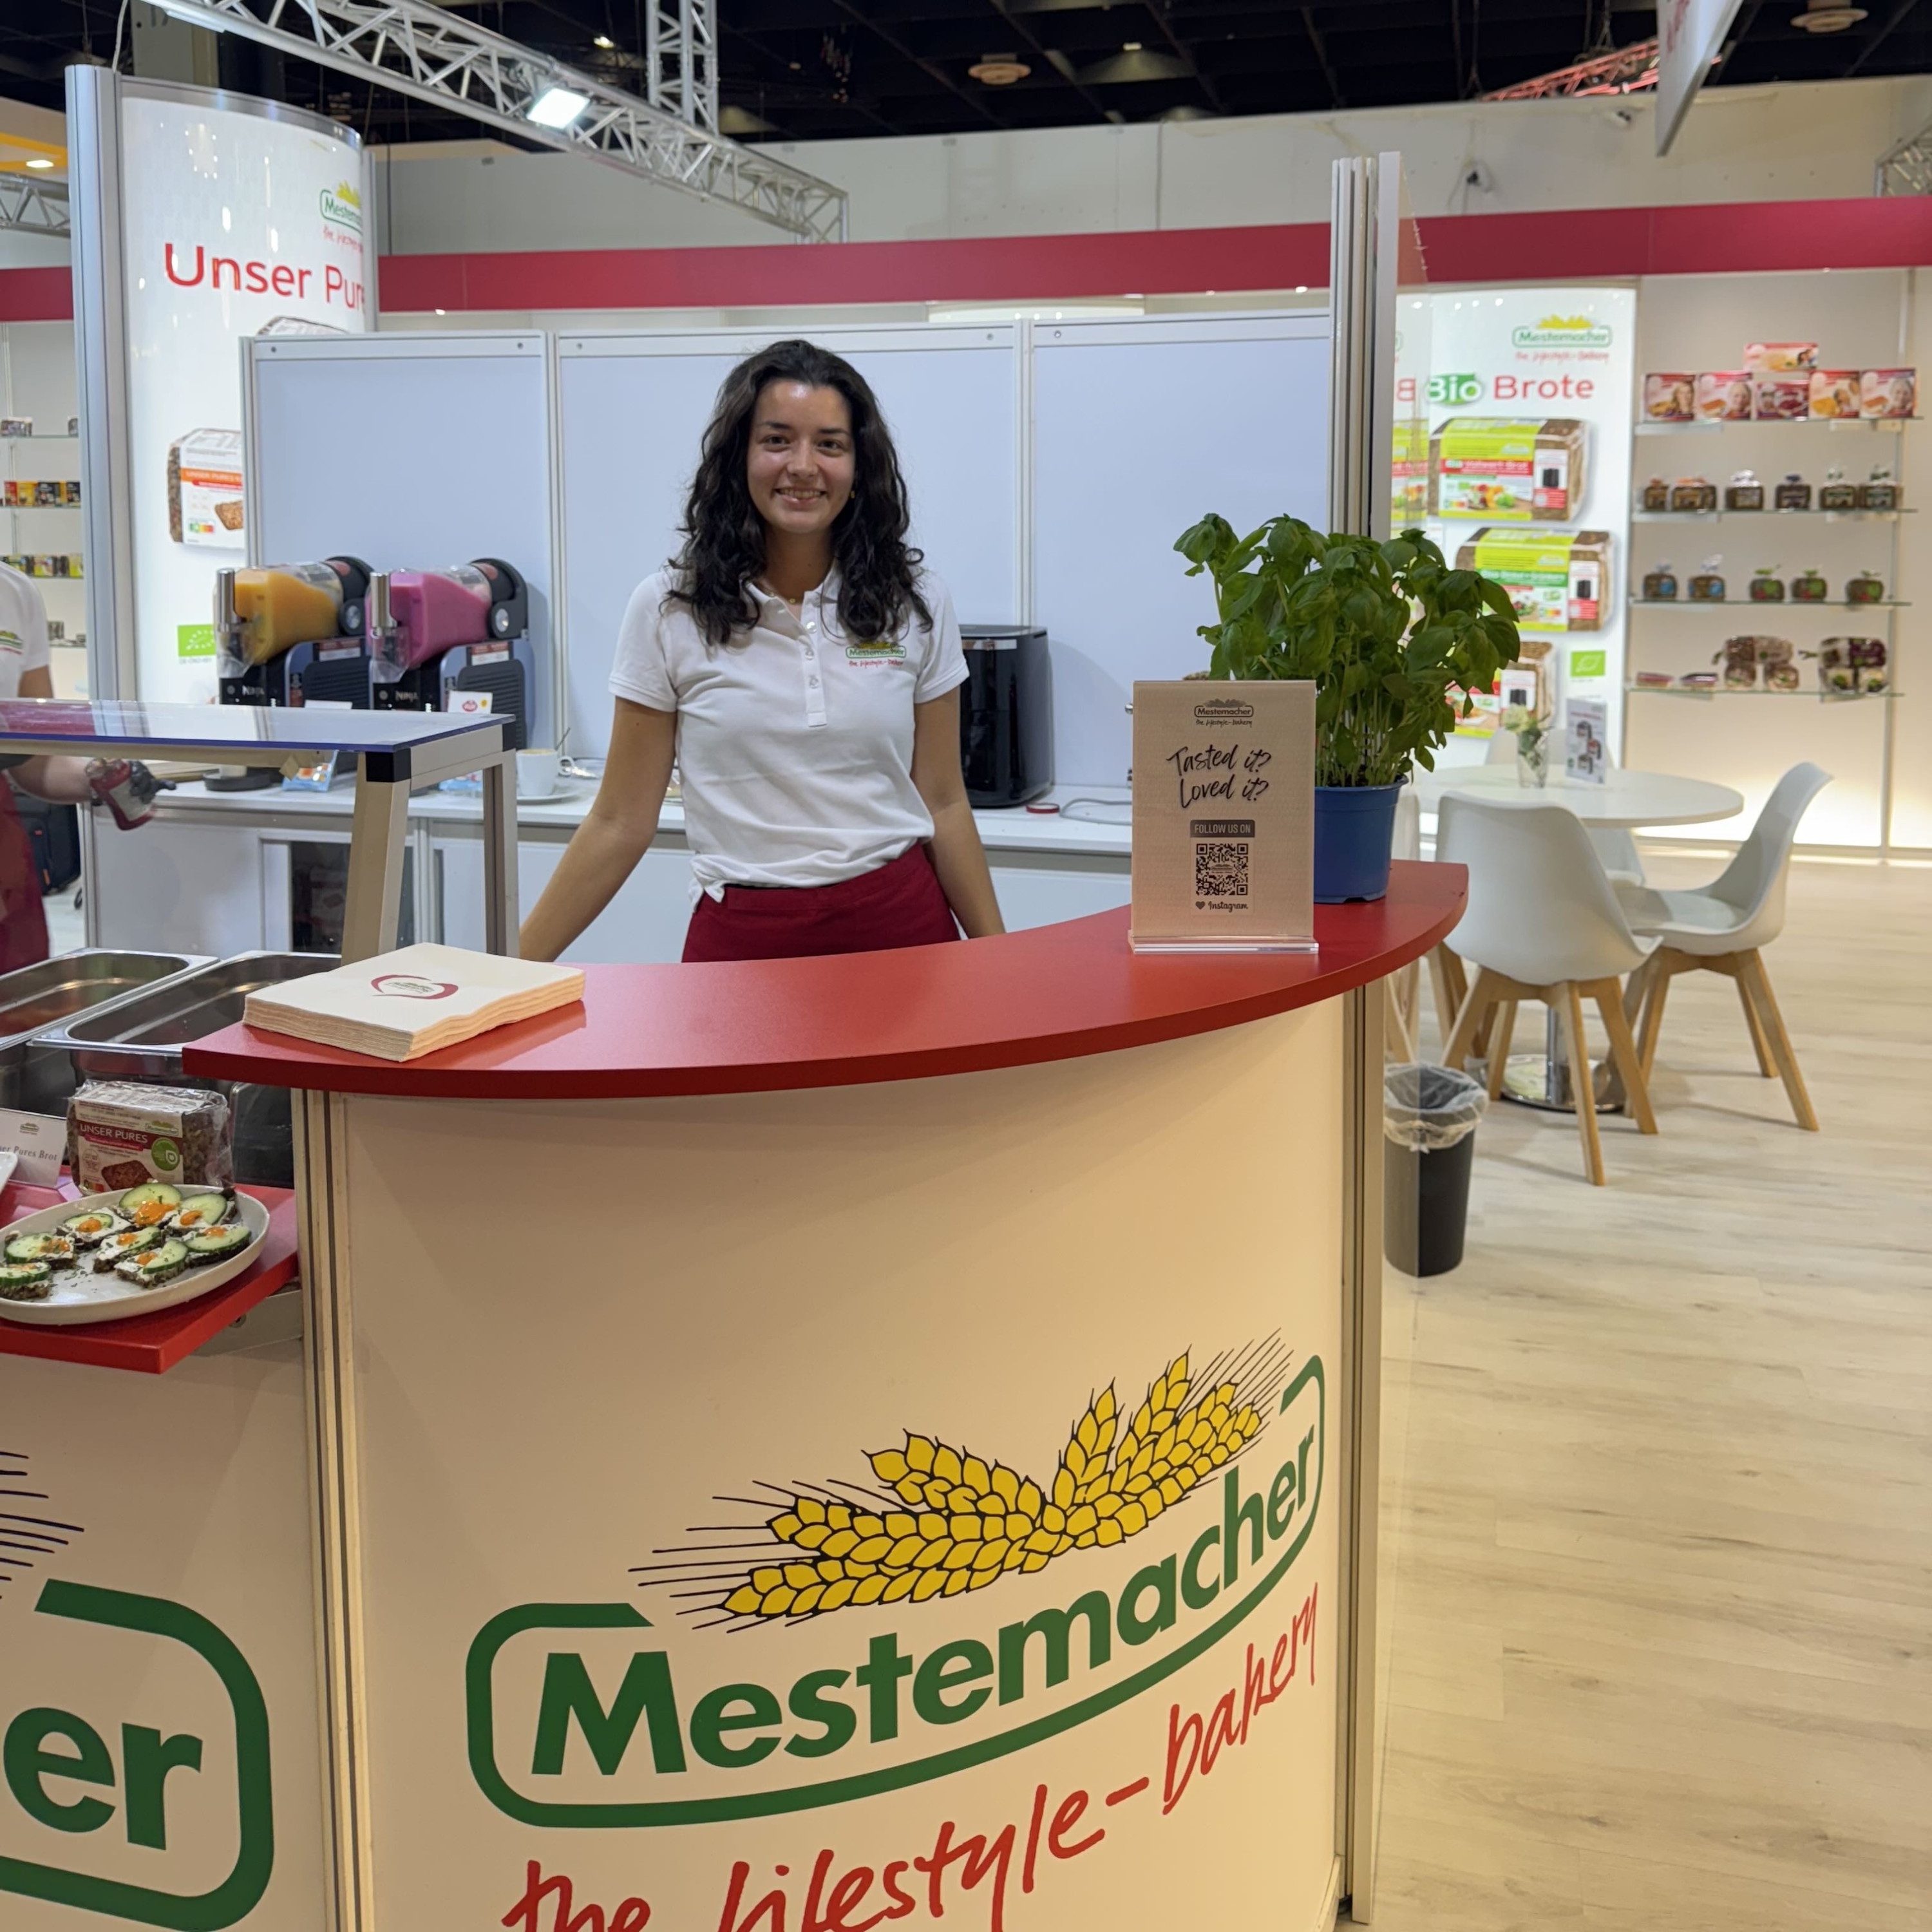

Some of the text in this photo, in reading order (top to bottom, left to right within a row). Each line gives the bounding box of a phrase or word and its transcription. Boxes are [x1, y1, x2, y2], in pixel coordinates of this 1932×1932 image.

[165, 243, 312, 299] Unser
[1425, 375, 1482, 402] Bio
[1493, 374, 1595, 400] Brote
[1197, 707, 1251, 715] Mestemacher
[1166, 744, 1272, 776] Tasted it?
[1180, 773, 1269, 808] Loved it?
[1194, 824, 1251, 833] FOLLOW US ON
[1208, 901, 1249, 913] Instagram
[80, 1123, 113, 1138] UNSER
[115, 1130, 148, 1144] PURES
[13, 1146, 37, 1158] Pures
[39, 1150, 58, 1161] Brot
[532, 1424, 1314, 1776] Mestemacher
